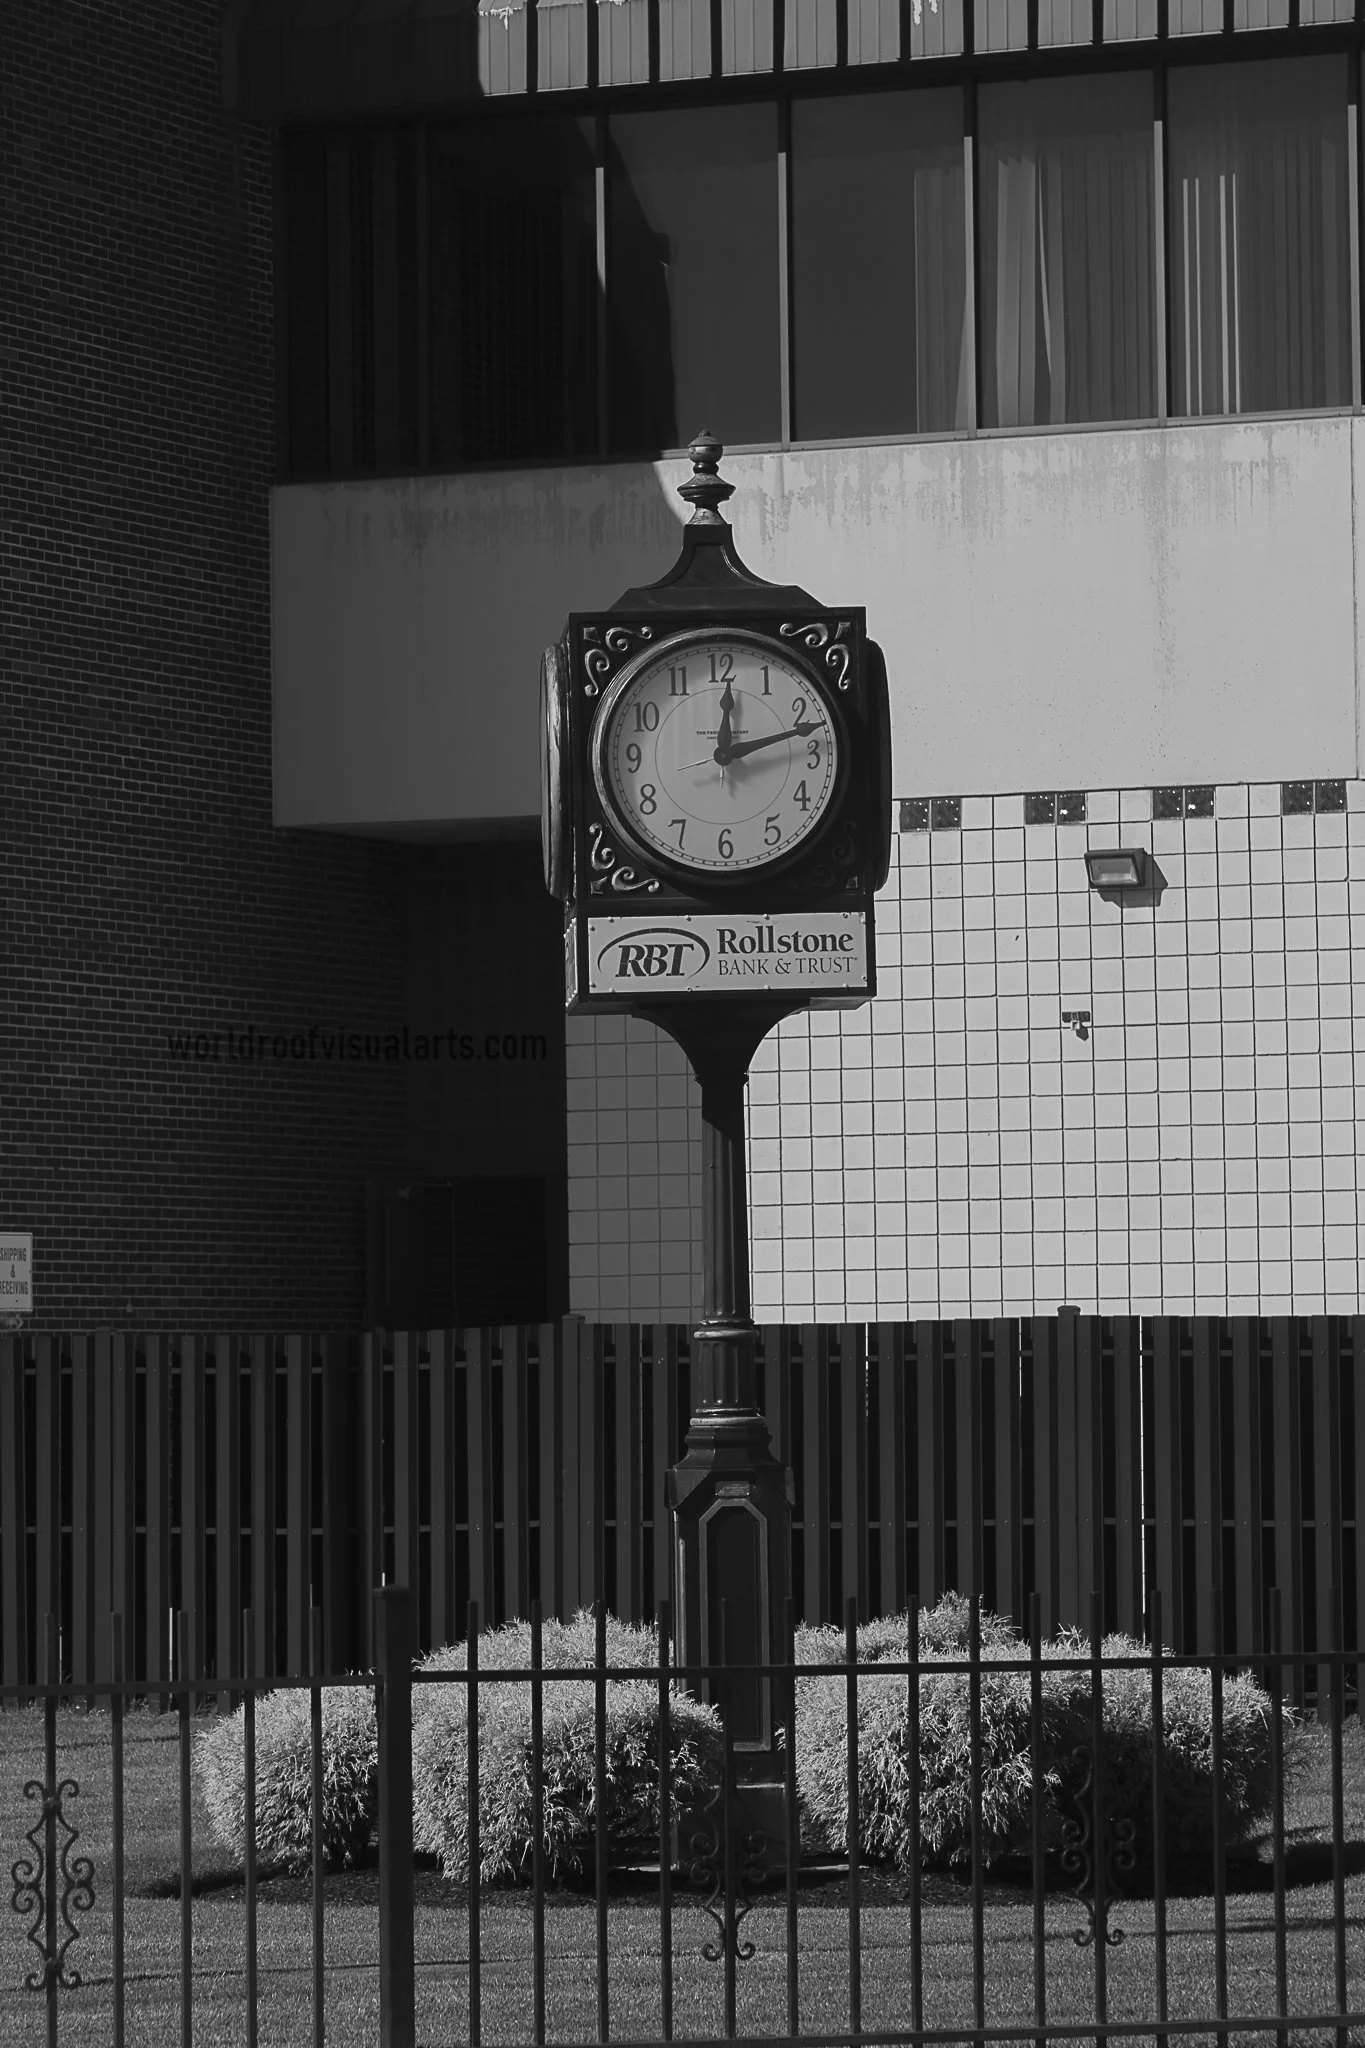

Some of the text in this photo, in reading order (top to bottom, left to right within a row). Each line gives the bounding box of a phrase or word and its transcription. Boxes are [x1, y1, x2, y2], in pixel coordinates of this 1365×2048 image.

[668, 666, 690, 696] 11
[708, 653, 737, 683] 12
[760, 665, 772, 695] 1
[633, 702, 660, 732] 10
[791, 697, 809, 728] 2
[626, 743, 642, 773] 9
[806, 739, 821, 769] 3
[639, 784, 657, 815] 8
[793, 780, 811, 811] 4
[668, 818, 686, 850] 7
[764, 812, 781, 845] 5
[718, 829, 734, 859] 6
[716, 925, 854, 954] Rollstone
[615, 943, 695, 978] RBT
[718, 956, 855, 976] BANK & TRUST
